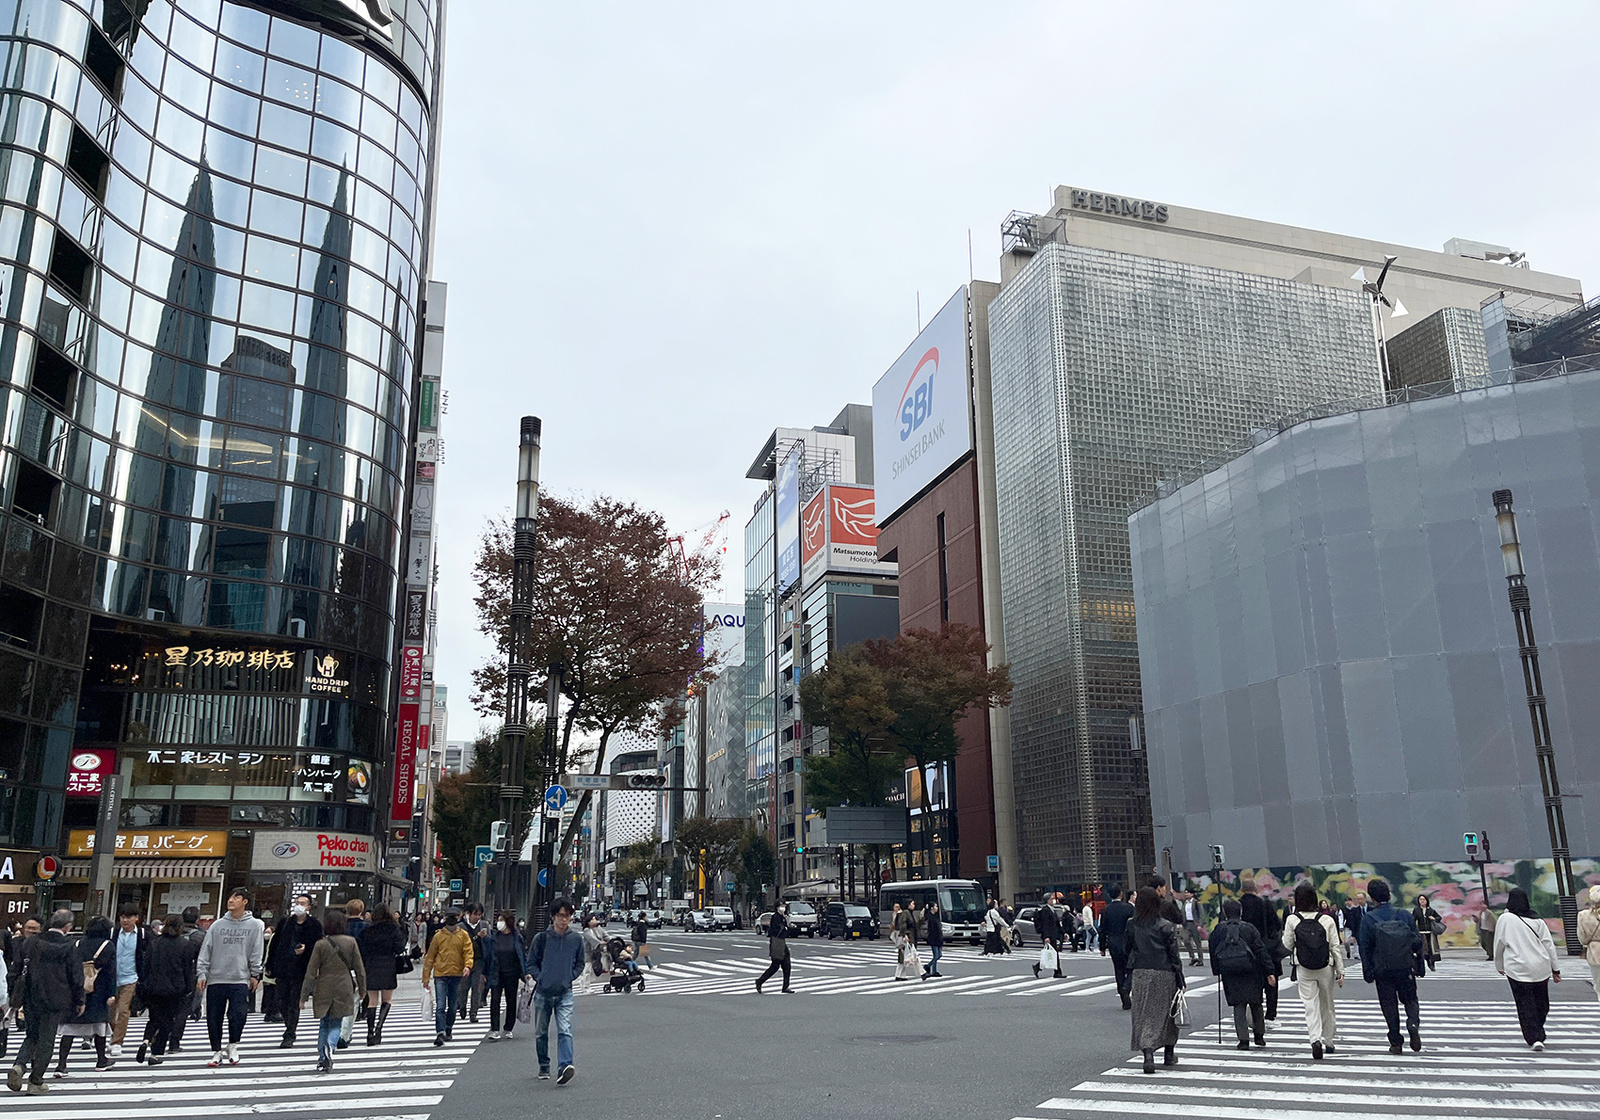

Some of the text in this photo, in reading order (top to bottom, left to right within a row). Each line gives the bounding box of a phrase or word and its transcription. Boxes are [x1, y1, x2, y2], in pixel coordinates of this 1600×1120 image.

[900, 373, 934, 442] SBI
[892, 418, 945, 480] SHINSEI BANK
[833, 547, 873, 557] Matsumoto
[409, 594, 422, 636] 星乃珈琲店
[164, 646, 296, 671] 星乃珈琲店
[403, 657, 411, 686] レストラン
[410, 658, 420, 687] 不二家
[305, 676, 350, 687] HAND DRIP
[311, 683, 342, 693] COFFEE
[147, 750, 264, 765] 不二家レストラン
[310, 754, 331, 765] 銀座
[397, 719, 413, 804] REGAL SHOES
[69, 772, 100, 782] 不二家
[297, 768, 341, 779] ハンバーグ
[303, 781, 334, 793] 不二家
[317, 834, 369, 853] Peko chan
[320, 851, 355, 867] House
[8, 901, 30, 914] B1F
[220, 928, 252, 937] GALLERY
